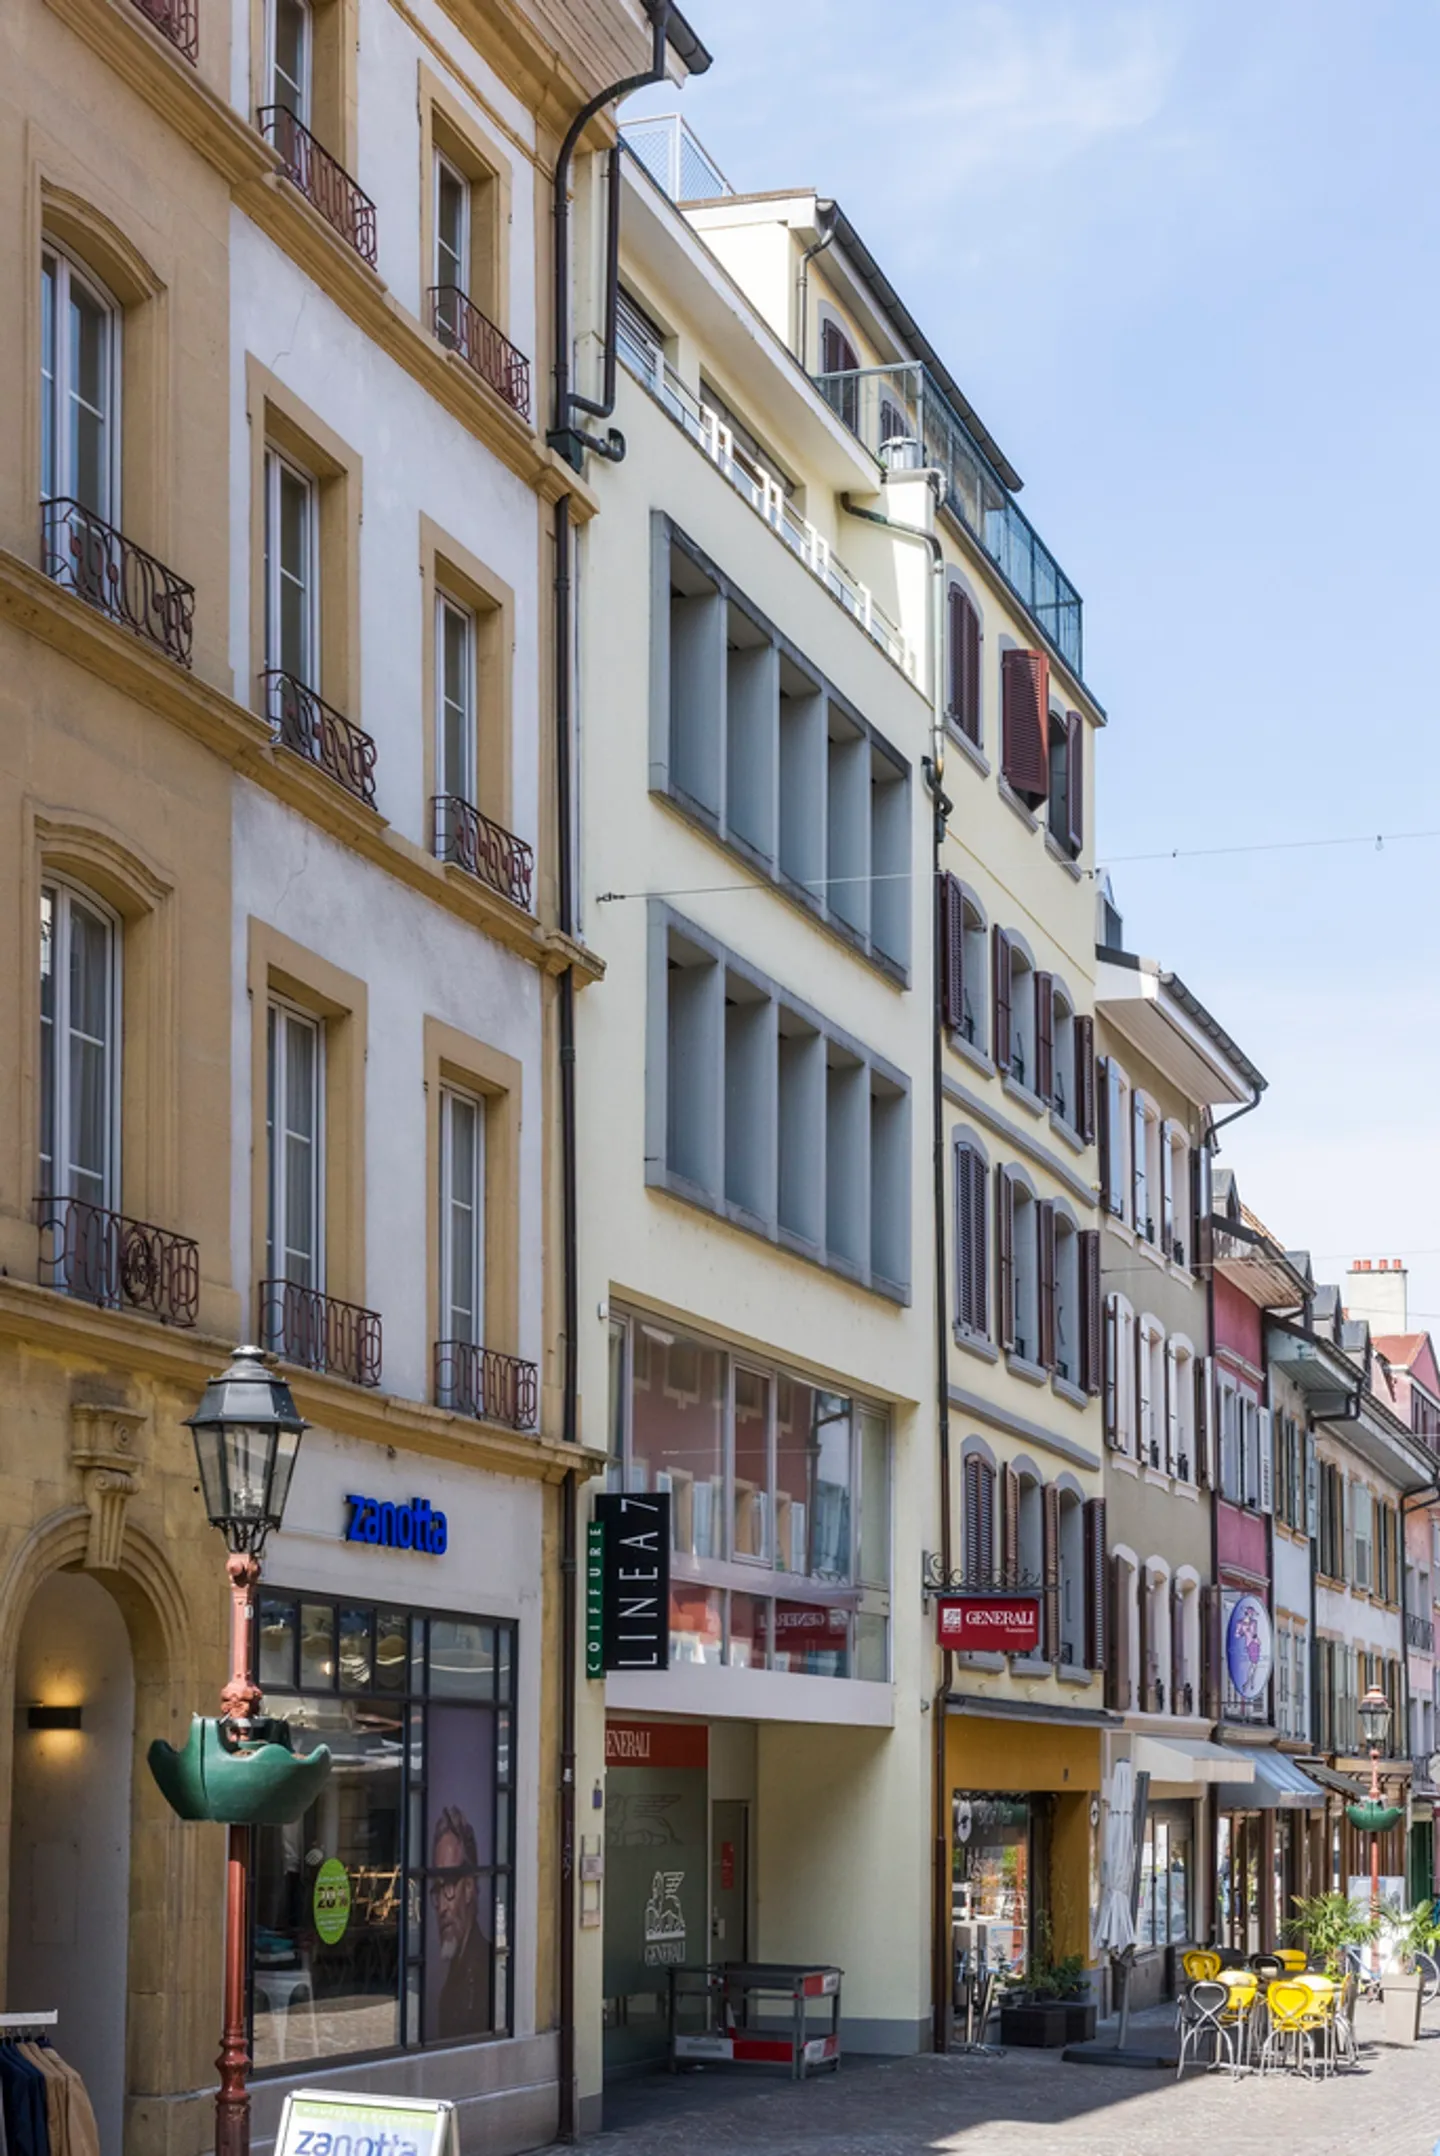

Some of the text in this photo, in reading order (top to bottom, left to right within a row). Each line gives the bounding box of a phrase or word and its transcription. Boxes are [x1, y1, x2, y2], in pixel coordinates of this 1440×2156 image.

[344, 1494, 448, 1555] zanotta
[588, 1528, 601, 1671] COIFFURE
[966, 1610, 1034, 1625] GENERALI
[295, 2130, 418, 2156] zanotta
